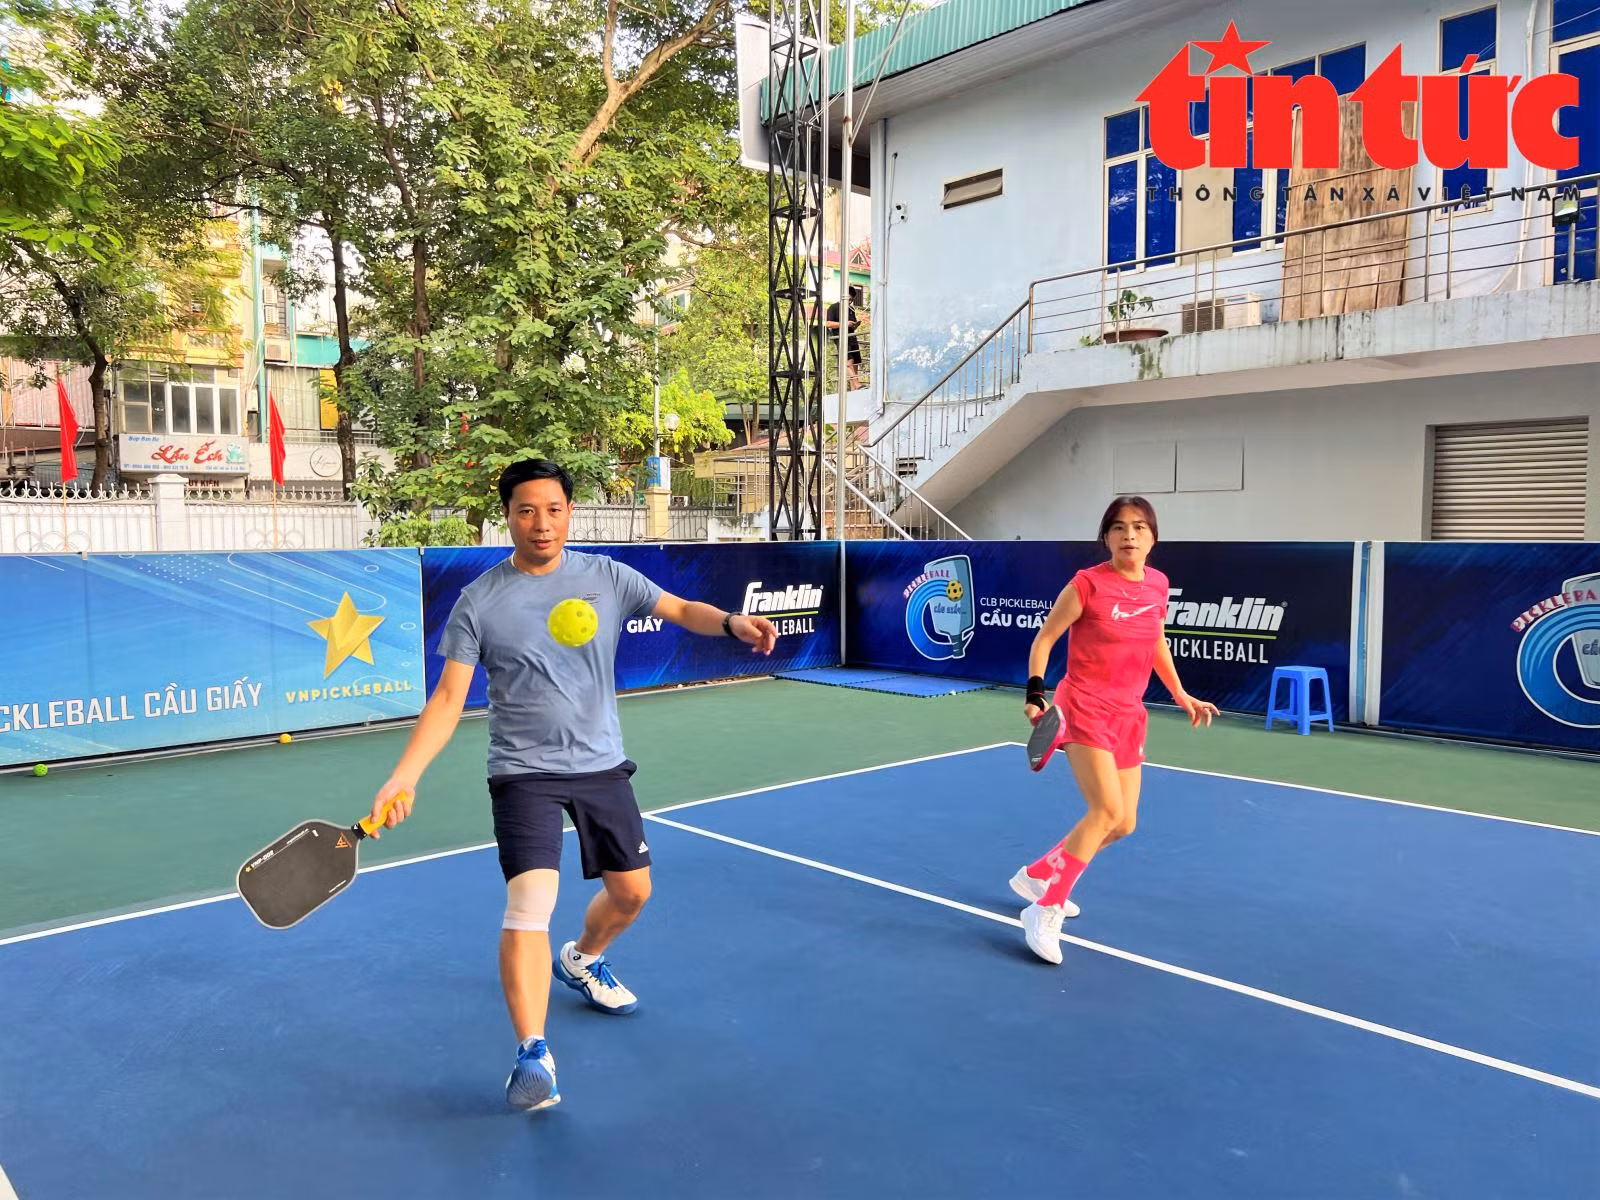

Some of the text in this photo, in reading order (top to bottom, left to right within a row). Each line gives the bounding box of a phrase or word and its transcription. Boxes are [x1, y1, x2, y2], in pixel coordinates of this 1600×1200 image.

[980, 597, 1055, 610] CLB PICKLEBALL
[626, 616, 664, 634] GIẤY
[771, 617, 815, 636] LEBALL
[980, 608, 1013, 627] CẦU
[144, 682, 198, 718] CẦU
[206, 676, 263, 712] GIẤY
[286, 679, 412, 704] VNPICKLEBALL
